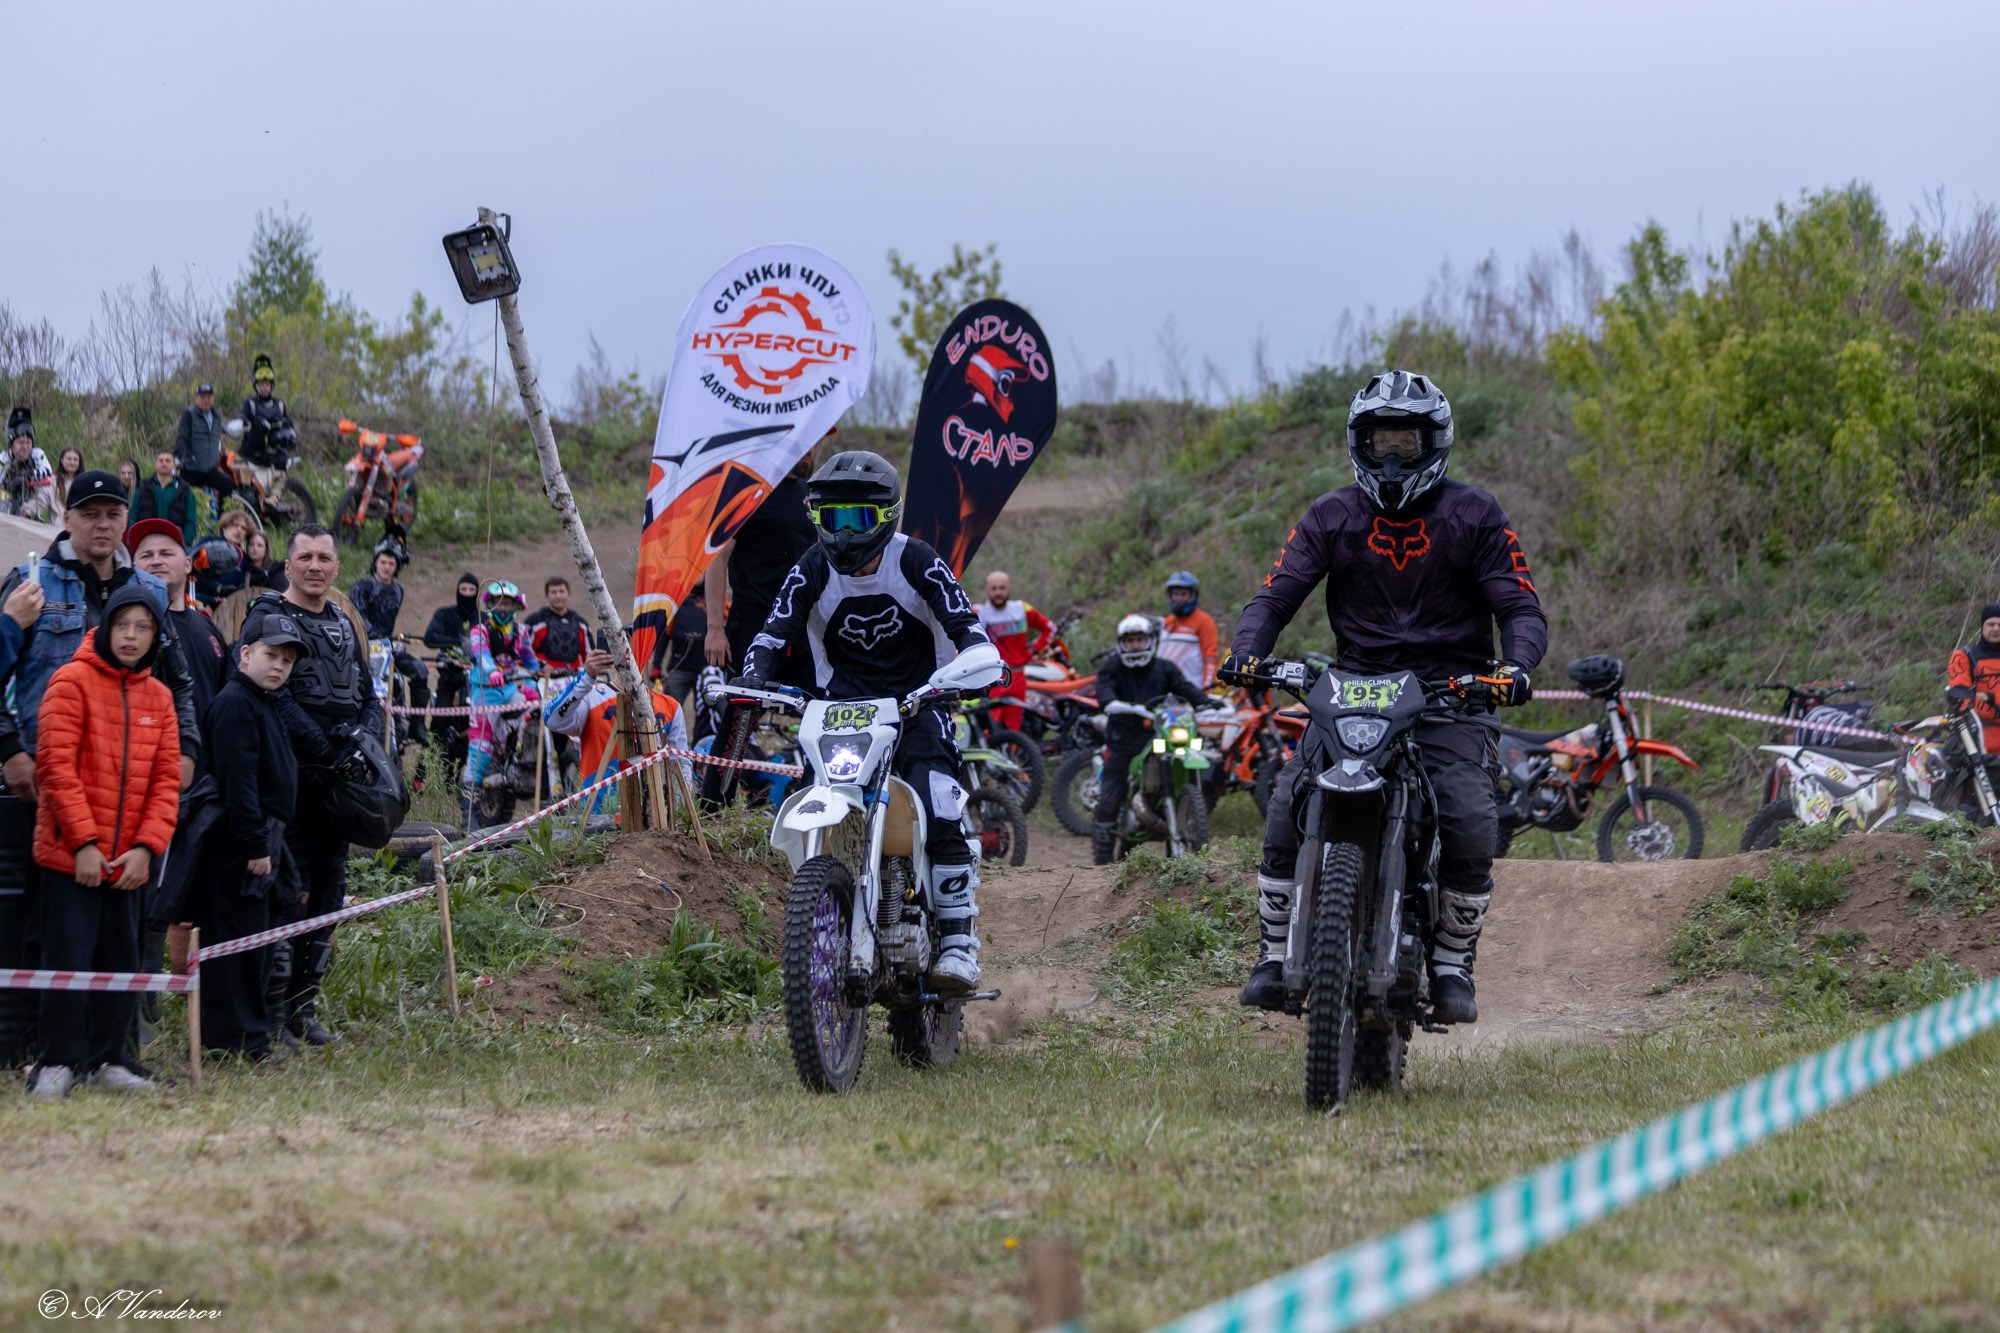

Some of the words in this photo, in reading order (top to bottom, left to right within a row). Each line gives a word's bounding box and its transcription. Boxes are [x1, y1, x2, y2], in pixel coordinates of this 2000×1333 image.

[713, 263, 791, 314] СТАНКИ
[800, 266, 841, 298] ЧПУ
[692, 332, 858, 361] HYPERCUT
[945, 315, 1049, 382] ENDURO
[700, 373, 727, 399] ДЛЯ
[724, 392, 772, 414] РЕЗКИ
[775, 376, 840, 414] МЕТАЛЛА
[1353, 687, 1381, 701] 95
[830, 709, 866, 722] 102
